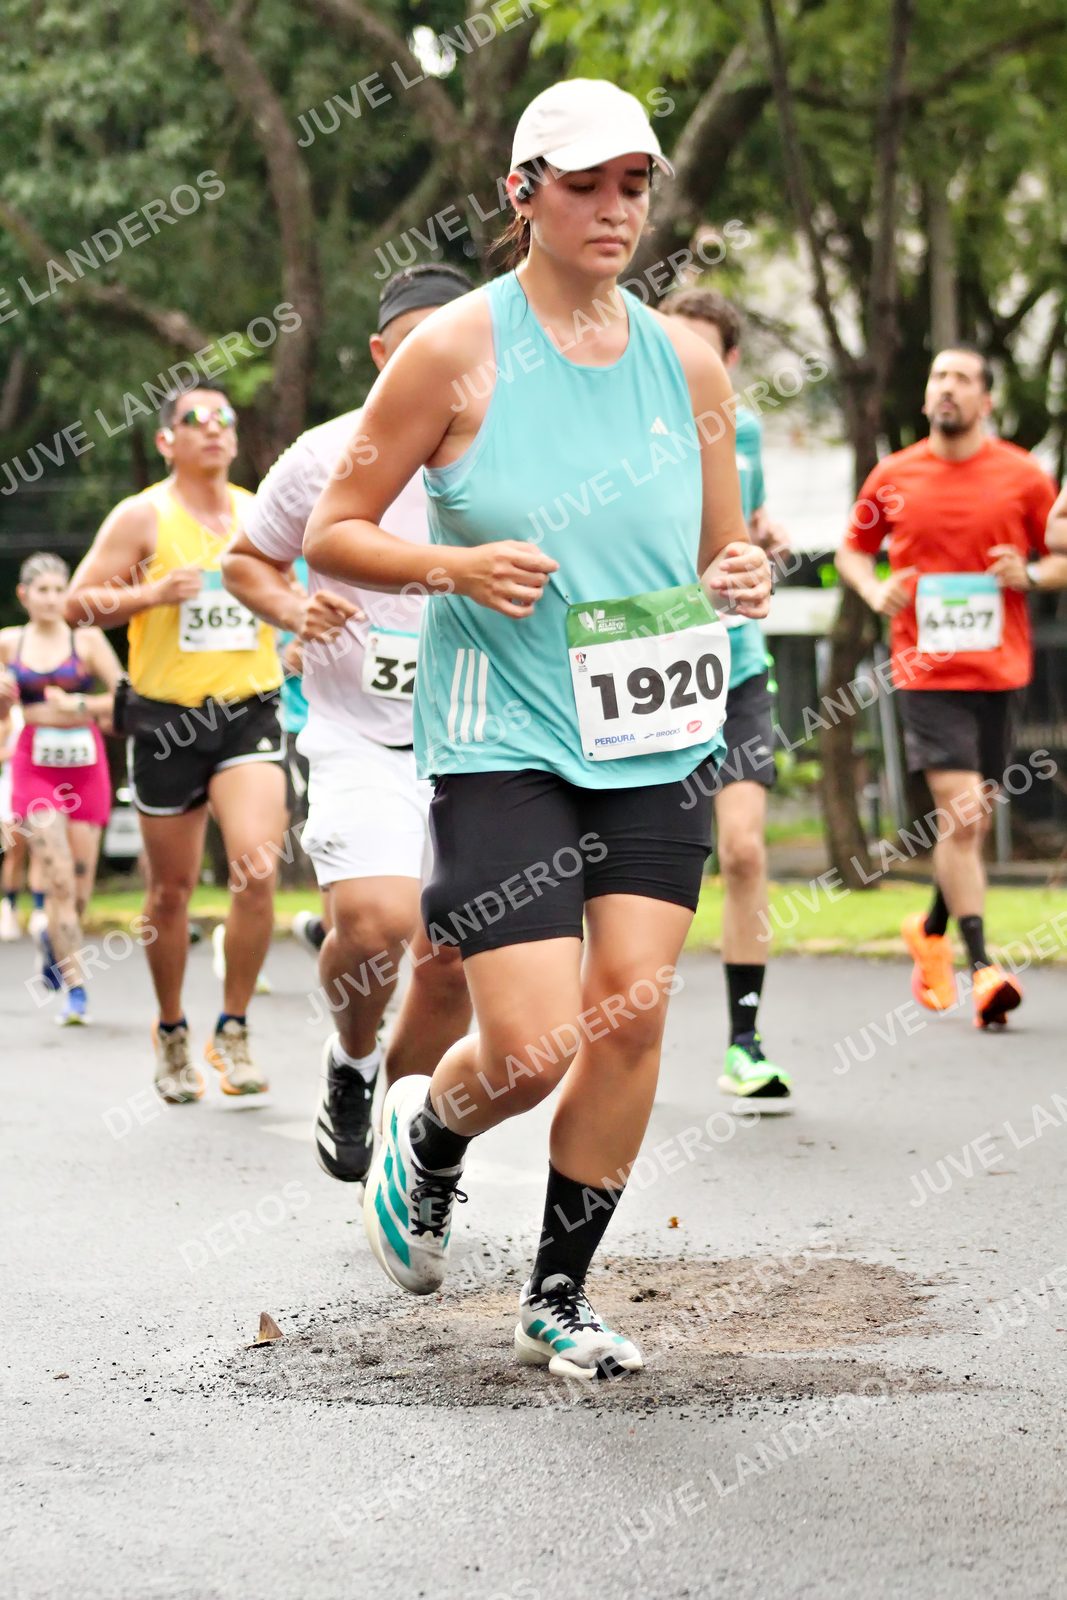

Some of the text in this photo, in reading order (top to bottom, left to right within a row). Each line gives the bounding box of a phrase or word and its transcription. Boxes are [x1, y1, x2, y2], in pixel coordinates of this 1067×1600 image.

[590, 653, 723, 720] 1920
[594, 728, 681, 746] PERDURA BROOKS
